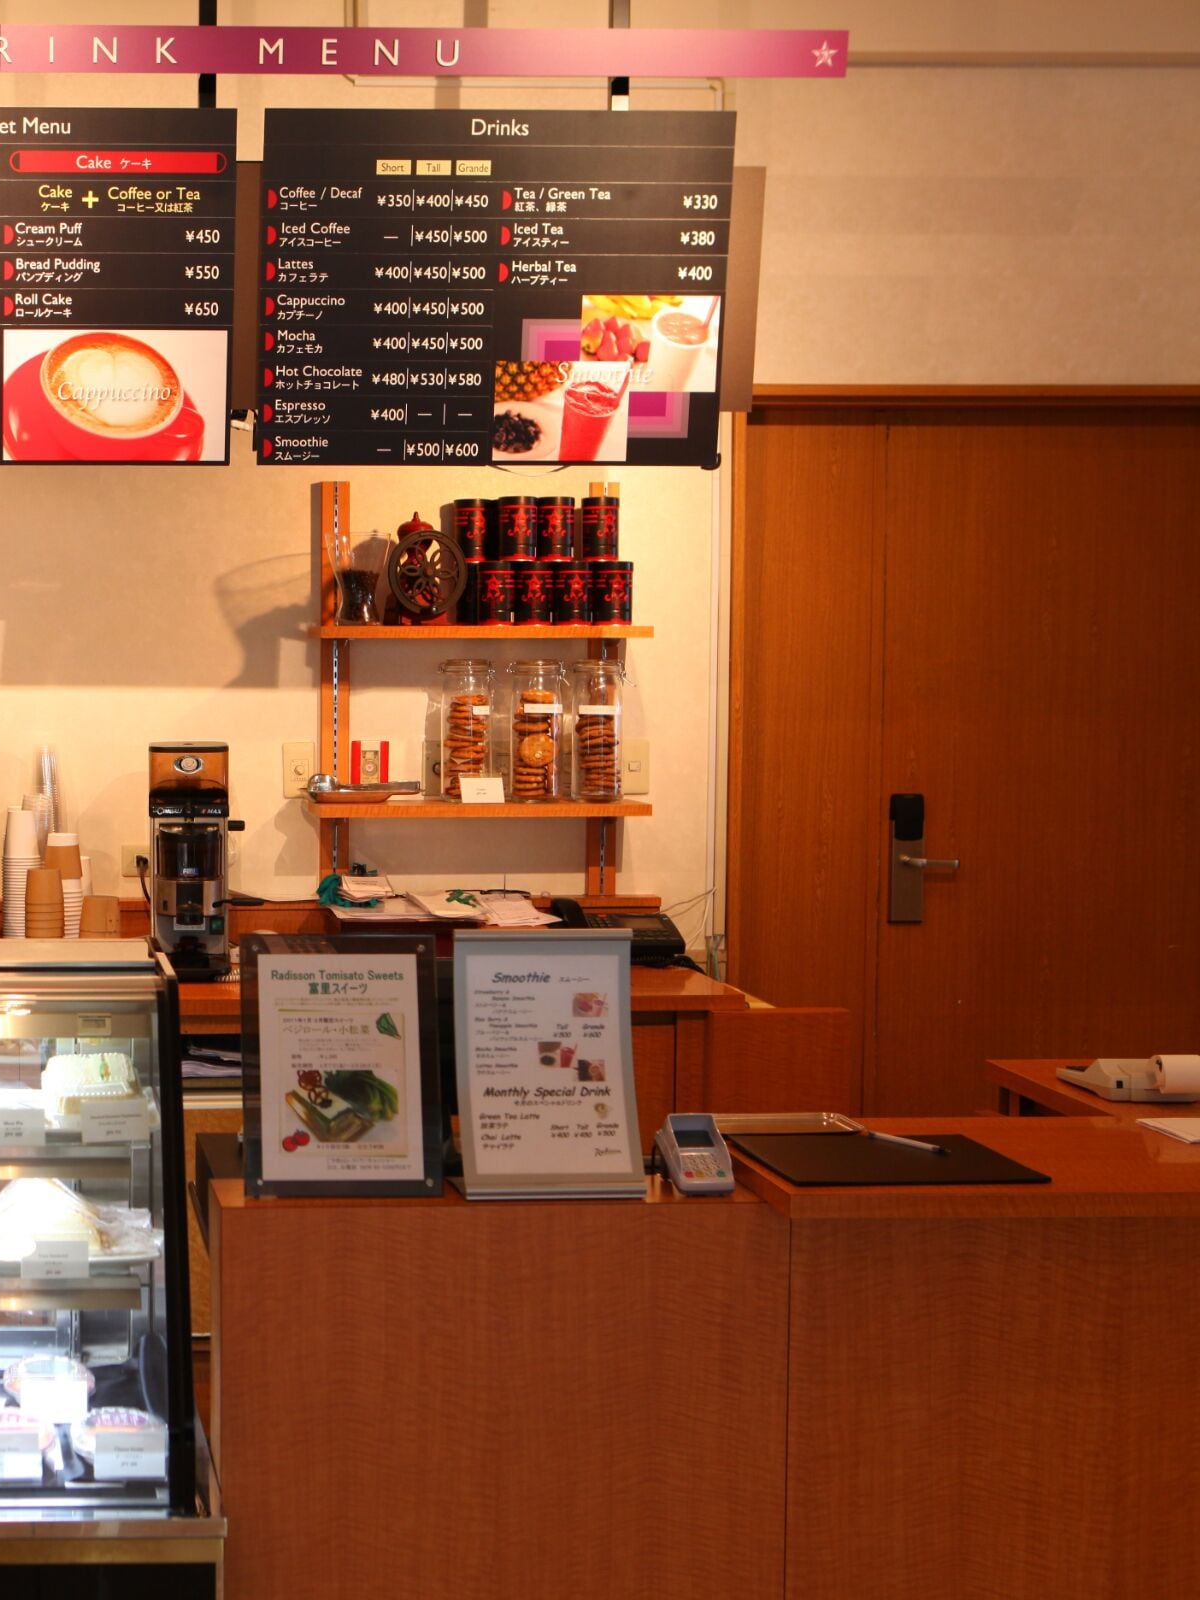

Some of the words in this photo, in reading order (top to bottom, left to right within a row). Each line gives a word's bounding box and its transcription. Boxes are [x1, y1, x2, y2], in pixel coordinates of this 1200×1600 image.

[260, 39, 459, 66] MENU
[23, 117, 70, 134] Menu
[472, 119, 529, 136] Drinks
[76, 155, 111, 168] Cake
[120, 158, 151, 169] ケーキ
[381, 162, 405, 173] Short
[426, 162, 441, 173] Tall
[458, 163, 489, 173] Grande
[39, 185, 72, 198] Cake
[108, 187, 151, 199] Coffee
[156, 191, 172, 199] or
[176, 187, 200, 200] Tea
[280, 187, 315, 198] Coffee
[331, 187, 362, 198] Decaf
[514, 188, 535, 199] Tea
[548, 188, 585, 199] Green
[589, 188, 610, 199] Tea
[281, 201, 317, 210] コーヒー
[378, 195, 411, 208] ¥350
[417, 195, 450, 207] ¥400
[455, 195, 488, 207] ¥450
[684, 195, 717, 209] ¥330
[15, 223, 55, 234] Cream
[60, 223, 82, 234] Puff
[282, 223, 305, 233] Iced
[311, 223, 350, 234] Coffee
[514, 223, 538, 234] Iced
[542, 223, 563, 234] Tea
[186, 230, 220, 243] ¥450
[416, 231, 449, 244] ¥450
[454, 231, 487, 243] ¥500
[681, 231, 715, 245] ¥380
[16, 258, 50, 269] Bread
[55, 258, 100, 274] Pudding
[279, 258, 313, 269] Lattes
[512, 261, 551, 272] Herbal
[555, 261, 576, 272] Tea
[186, 266, 219, 279] ¥550
[278, 273, 328, 282] カフェラテ
[678, 266, 712, 280] ¥400
[15, 293, 37, 304] Roll
[42, 293, 72, 305] Cake
[277, 294, 345, 311] Cappuccino
[16, 308, 72, 317] ロールケーキ
[185, 302, 218, 315] ¥650
[278, 330, 315, 341] Mocha
[276, 366, 298, 376] Hot
[303, 366, 362, 376] Chocolate
[372, 373, 405, 385] ¥480
[411, 373, 443, 387] ¥530
[449, 374, 481, 385] ¥580
[57, 381, 172, 410] Cappuccino
[275, 399, 325, 413] Espresso
[371, 409, 404, 422] ¥400
[275, 436, 328, 447] Smoothie
[407, 443, 439, 456] ¥500
[446, 443, 478, 456] ¥600
[271, 970, 315, 980] Radisson
[319, 970, 364, 980] Tomisato
[368, 970, 404, 980] Sweets
[492, 972, 551, 983] Smoothie
[483, 1087, 530, 1100] Monthly
[534, 1086, 576, 1100] Special
[580, 1086, 611, 1097] Drink
